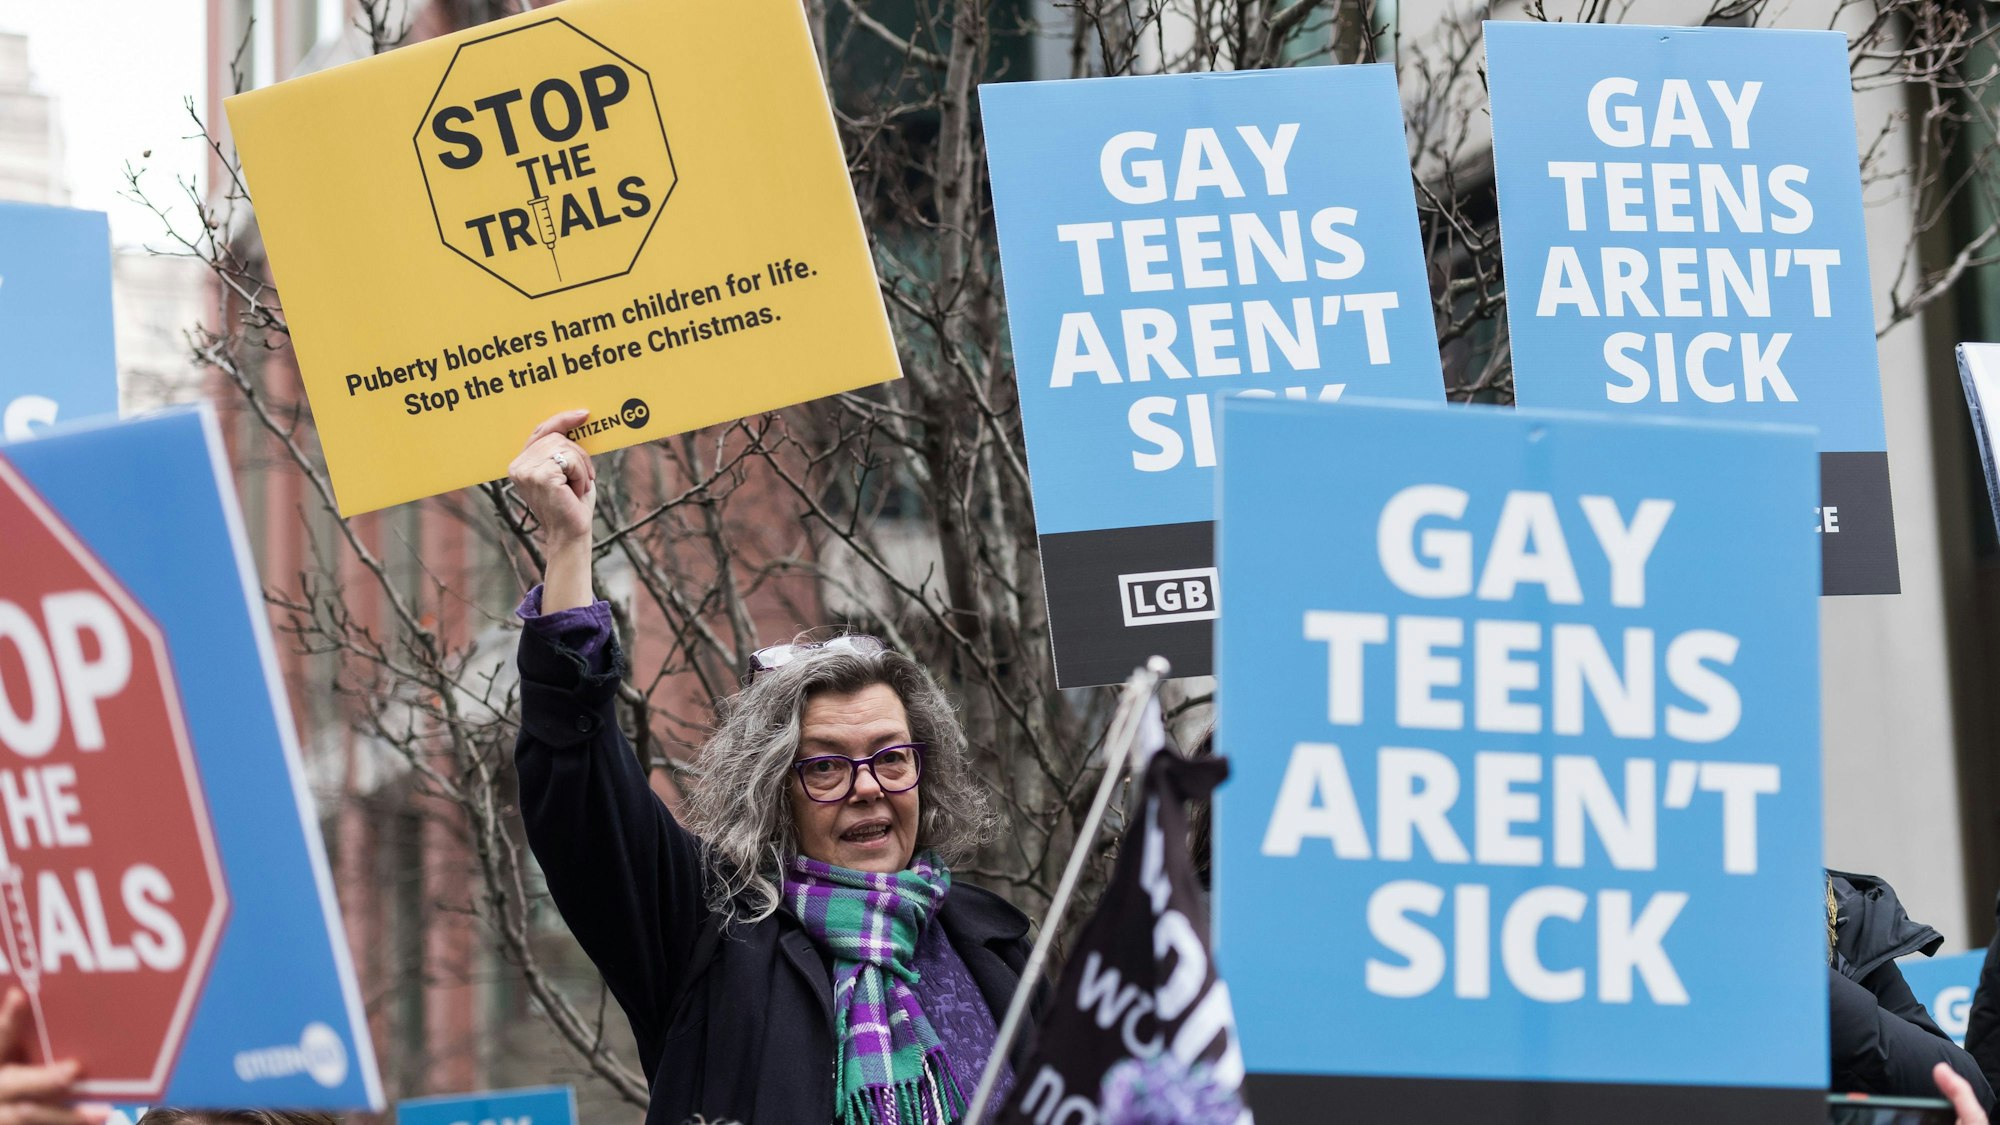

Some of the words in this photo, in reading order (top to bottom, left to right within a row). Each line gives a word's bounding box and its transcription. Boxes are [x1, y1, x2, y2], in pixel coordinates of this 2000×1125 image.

[431, 64, 630, 170] STOP
[1587, 77, 1763, 149] GAY
[516, 143, 596, 199] THE
[1100, 123, 1301, 205] GAY
[1547, 161, 1815, 234] TEENS
[1057, 207, 1366, 296] TEENS
[1536, 246, 1841, 318] AREN'T
[345, 357, 438, 397] Puberty
[442, 335, 548, 371] blockers
[551, 313, 616, 343] harm
[622, 288, 722, 324] children
[726, 273, 761, 297] for
[767, 258, 817, 286] life.
[404, 388, 460, 416] Stop
[464, 375, 504, 400] the
[508, 356, 559, 389] trial
[562, 341, 642, 375] before
[647, 314, 781, 353] Christmas.
[1049, 292, 1399, 389] AREN'T
[1603, 331, 1799, 404] SICK
[1377, 484, 1676, 608] GAY
[1133, 580, 1208, 614] LGB
[0, 590, 133, 757] OP
[1303, 610, 1743, 743] TEENS
[1261, 742, 1781, 875] AREN'T
[1365, 880, 1691, 1006] SICK
